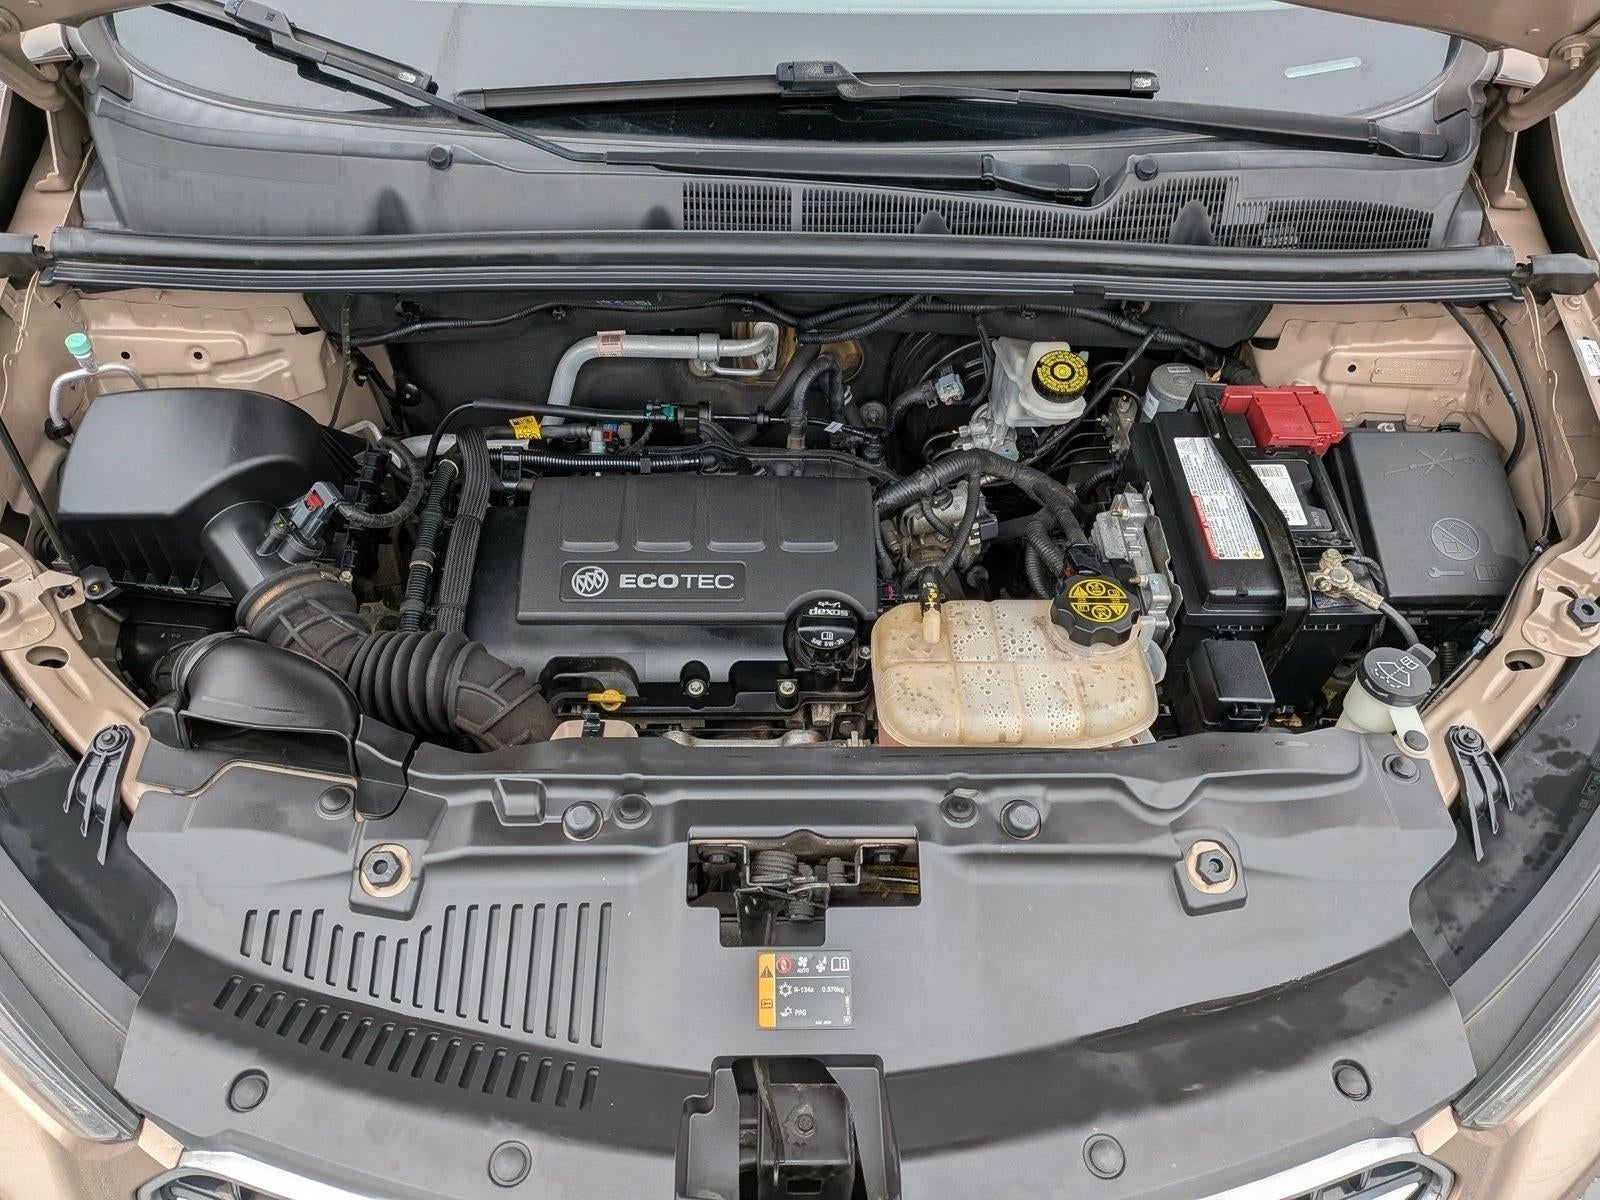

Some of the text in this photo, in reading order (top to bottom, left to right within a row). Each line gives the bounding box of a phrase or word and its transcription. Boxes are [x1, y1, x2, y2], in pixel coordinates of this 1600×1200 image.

[619, 573, 735, 590] ECOTEC
[808, 606, 850, 617] dexos
[811, 637, 823, 647] SAE
